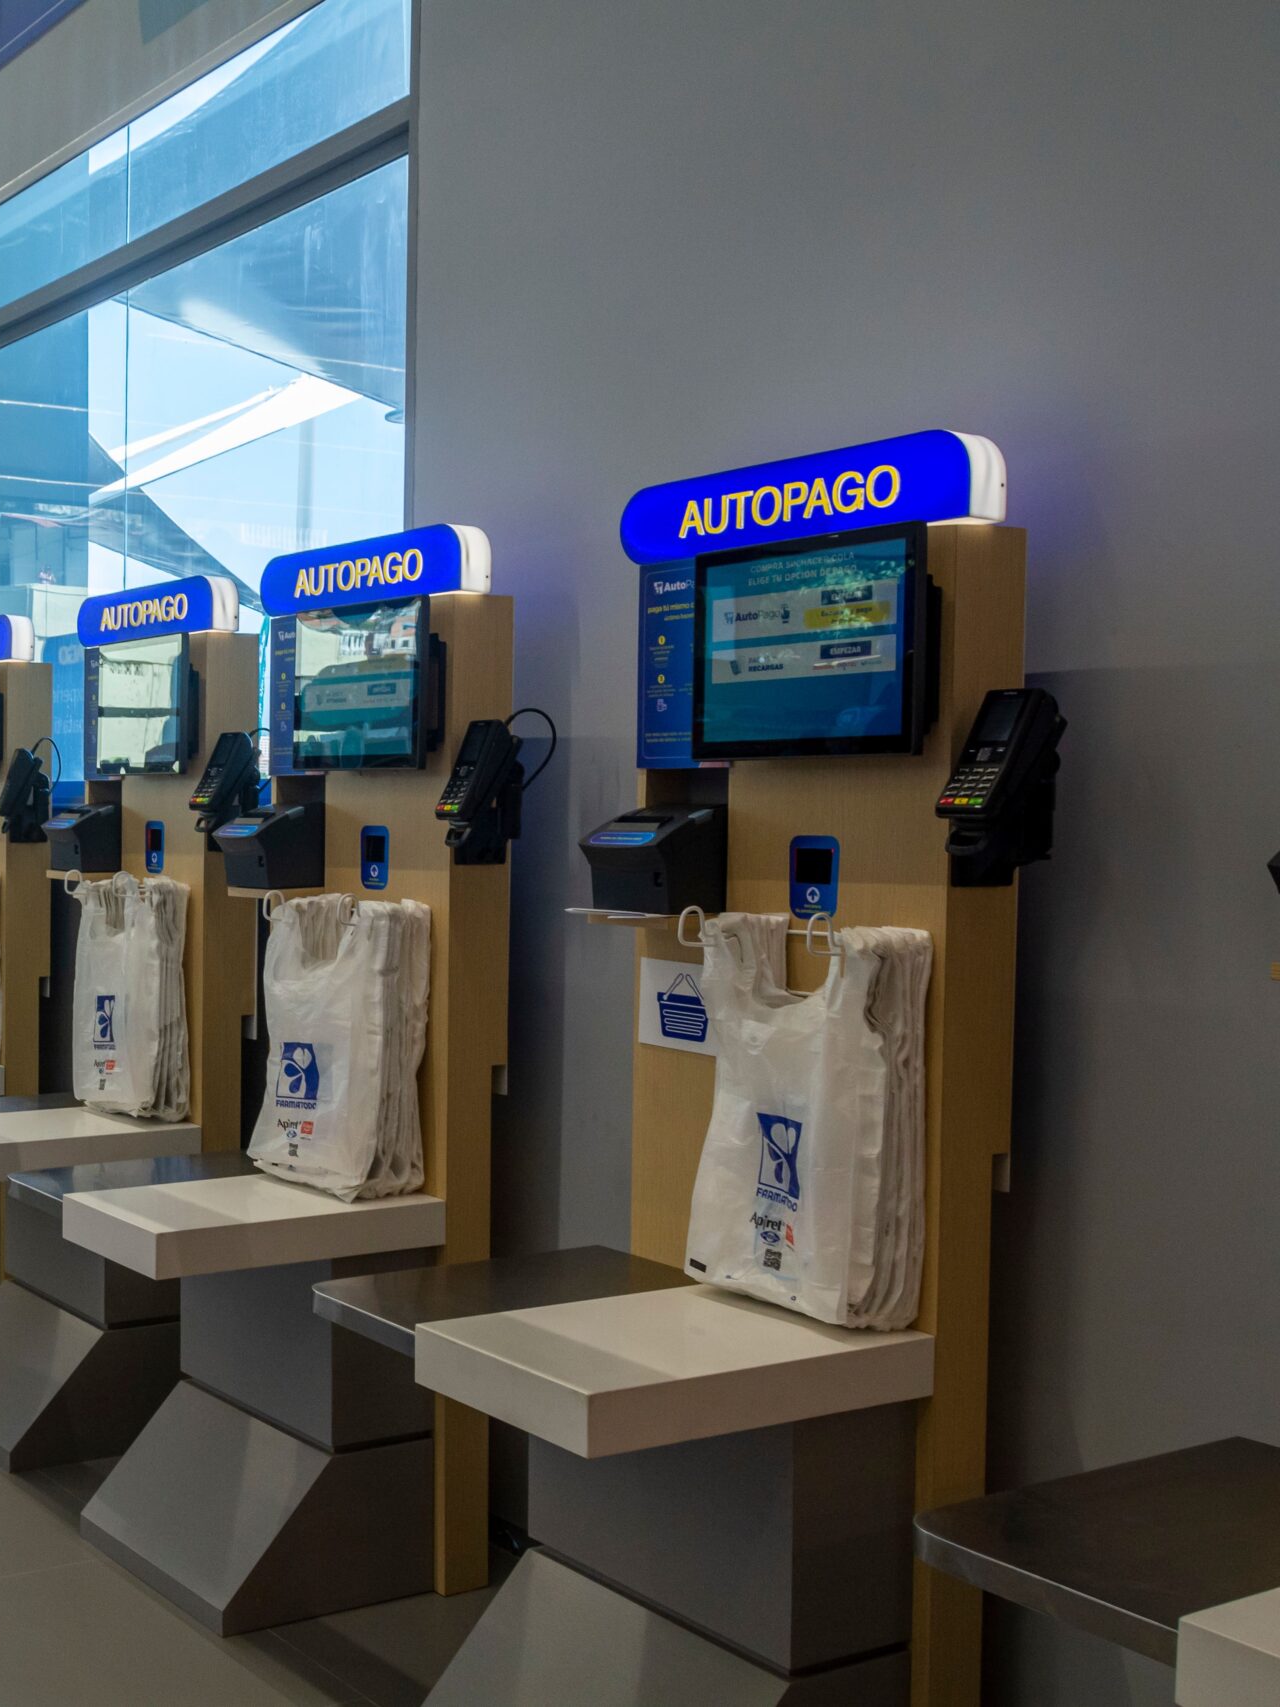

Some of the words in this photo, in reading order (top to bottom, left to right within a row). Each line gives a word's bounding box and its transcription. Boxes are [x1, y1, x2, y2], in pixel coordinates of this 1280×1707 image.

[678, 464, 901, 540] AUTOPAGO
[294, 548, 424, 600] AUTOPAGO
[99, 592, 188, 632] AUTOPAGO
